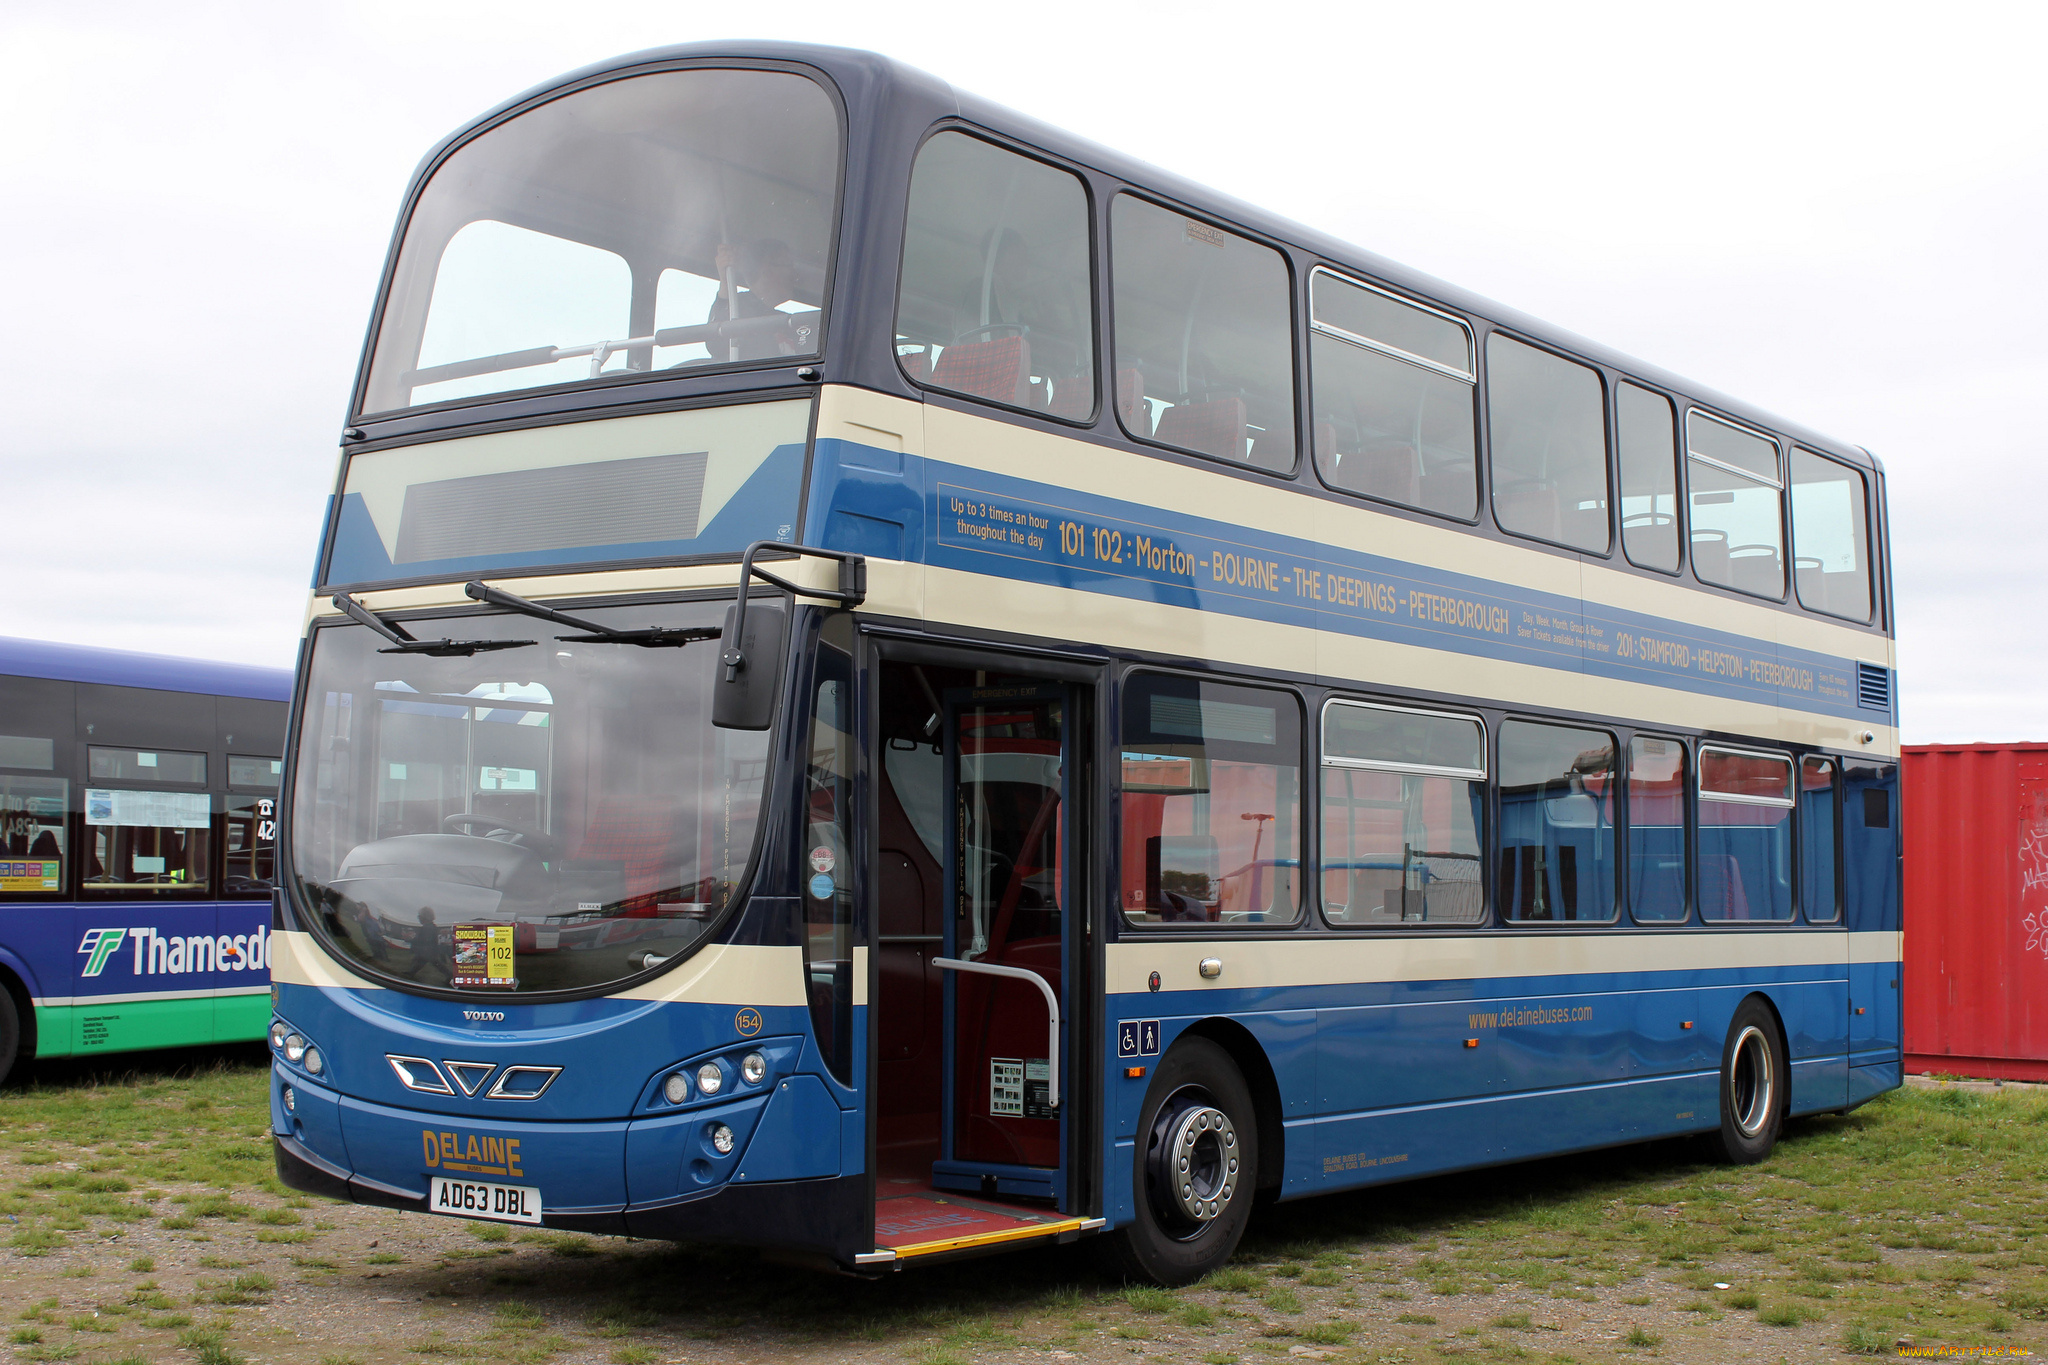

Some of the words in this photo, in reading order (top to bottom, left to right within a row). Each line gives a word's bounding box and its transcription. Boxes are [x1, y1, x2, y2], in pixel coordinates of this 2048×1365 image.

[951, 497, 964, 515] Up
[967, 501, 977, 516] to
[980, 503, 986, 517] 3
[989, 505, 1013, 523] times
[1015, 513, 1026, 526] an
[1029, 513, 1049, 529] hour
[957, 519, 1006, 541] throughout
[1010, 529, 1024, 545] the
[1027, 532, 1044, 550] day
[1059, 521, 1084, 556] 101
[1093, 527, 1122, 564] 102
[1136, 535, 1195, 577] Morton
[1213, 551, 1279, 592] BOURNE
[1293, 567, 1321, 600] THE
[1327, 574, 1396, 615] DEEPINGS
[1410, 590, 1509, 635] PETERBOROUGH
[1517, 625, 1531, 638] Saver
[1533, 628, 1551, 642] Tickets
[1553, 634, 1574, 646] available
[1576, 636, 1586, 648] from
[1597, 641, 1609, 653] driver
[1570, 621, 1584, 635] Group
[1616, 632, 1633, 658] 201
[1639, 638, 1690, 668] STAMFORD
[1698, 649, 1743, 679] HELPSTON
[1750, 659, 1813, 692] PETERBOROUGH
[972, 688, 1017, 699] EMERGENCY
[1020, 687, 1037, 696] EXIT
[491, 947, 511, 959] 102
[463, 1010, 505, 1022] VOLVO
[738, 1015, 759, 1029] 154
[1468, 1004, 1593, 1029] www.delainebuses.com
[423, 1130, 524, 1177] DELAINE
[1323, 1156, 1341, 1165] DELAINE
[1343, 1153, 1357, 1163] BUSES
[439, 1182, 488, 1211] AD63
[494, 1187, 532, 1217] DBL
